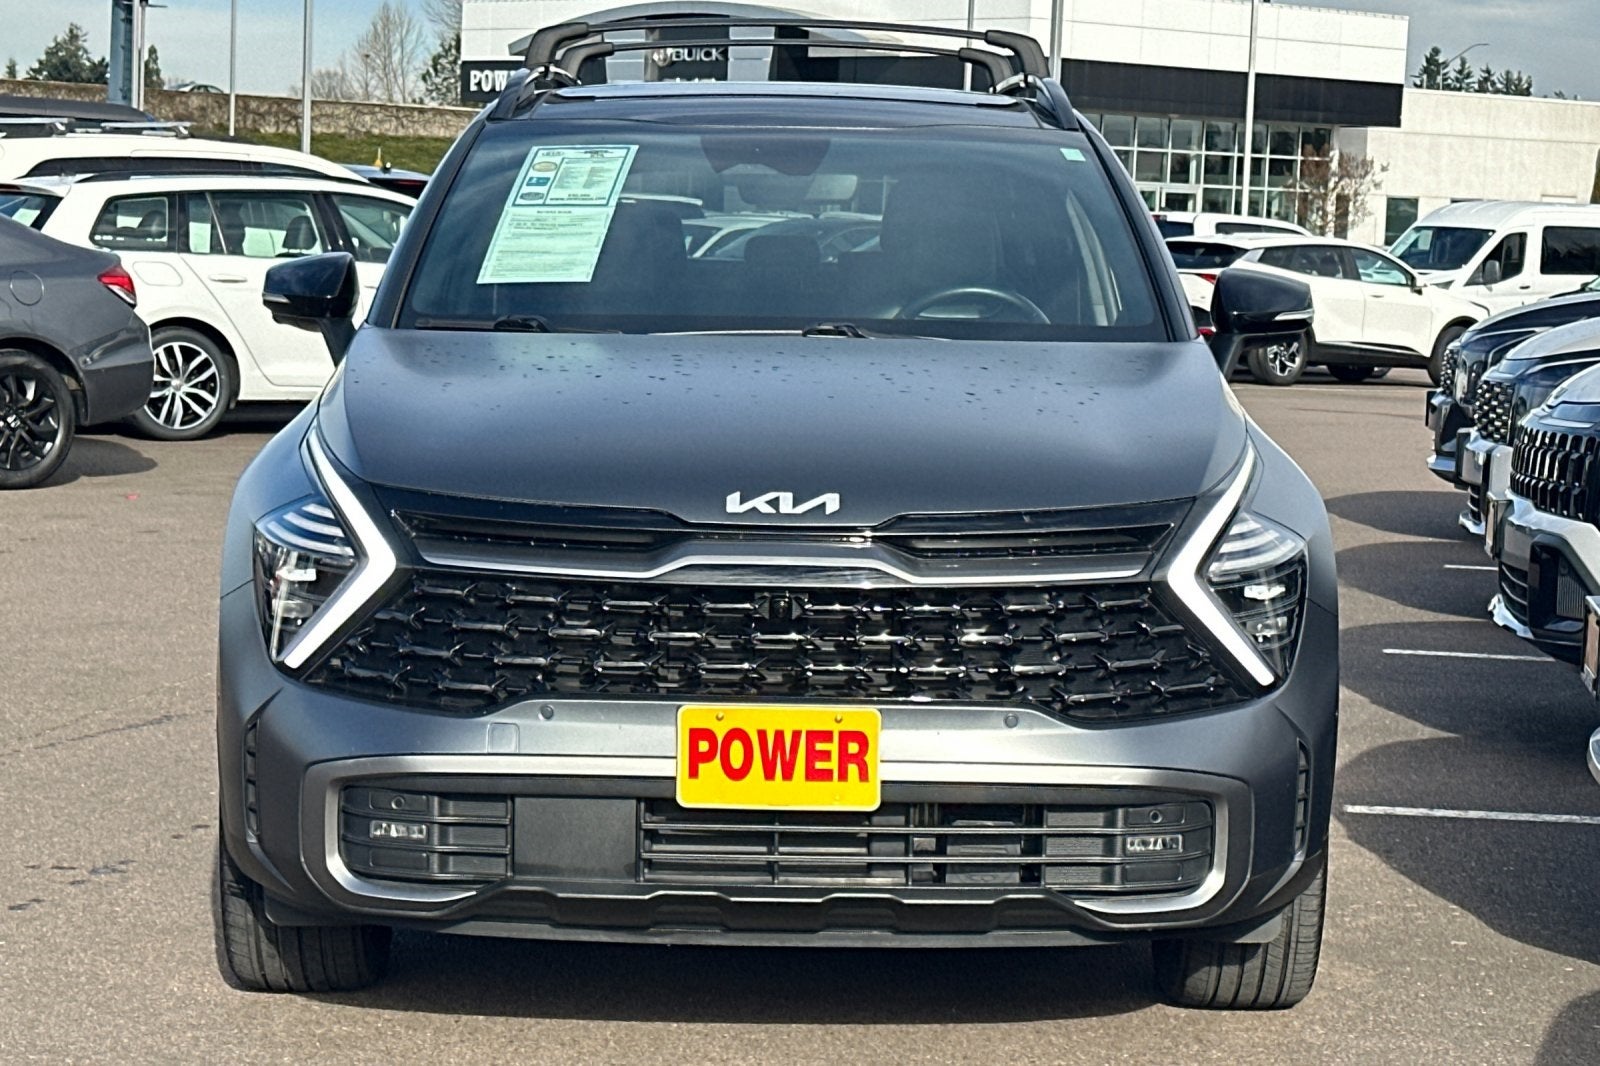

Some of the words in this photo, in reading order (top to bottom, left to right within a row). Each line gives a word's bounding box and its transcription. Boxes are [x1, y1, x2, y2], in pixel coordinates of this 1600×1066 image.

[672, 47, 725, 61] BUICK
[469, 69, 516, 92] POW
[726, 491, 840, 515] KIA
[688, 727, 869, 782] POWER
